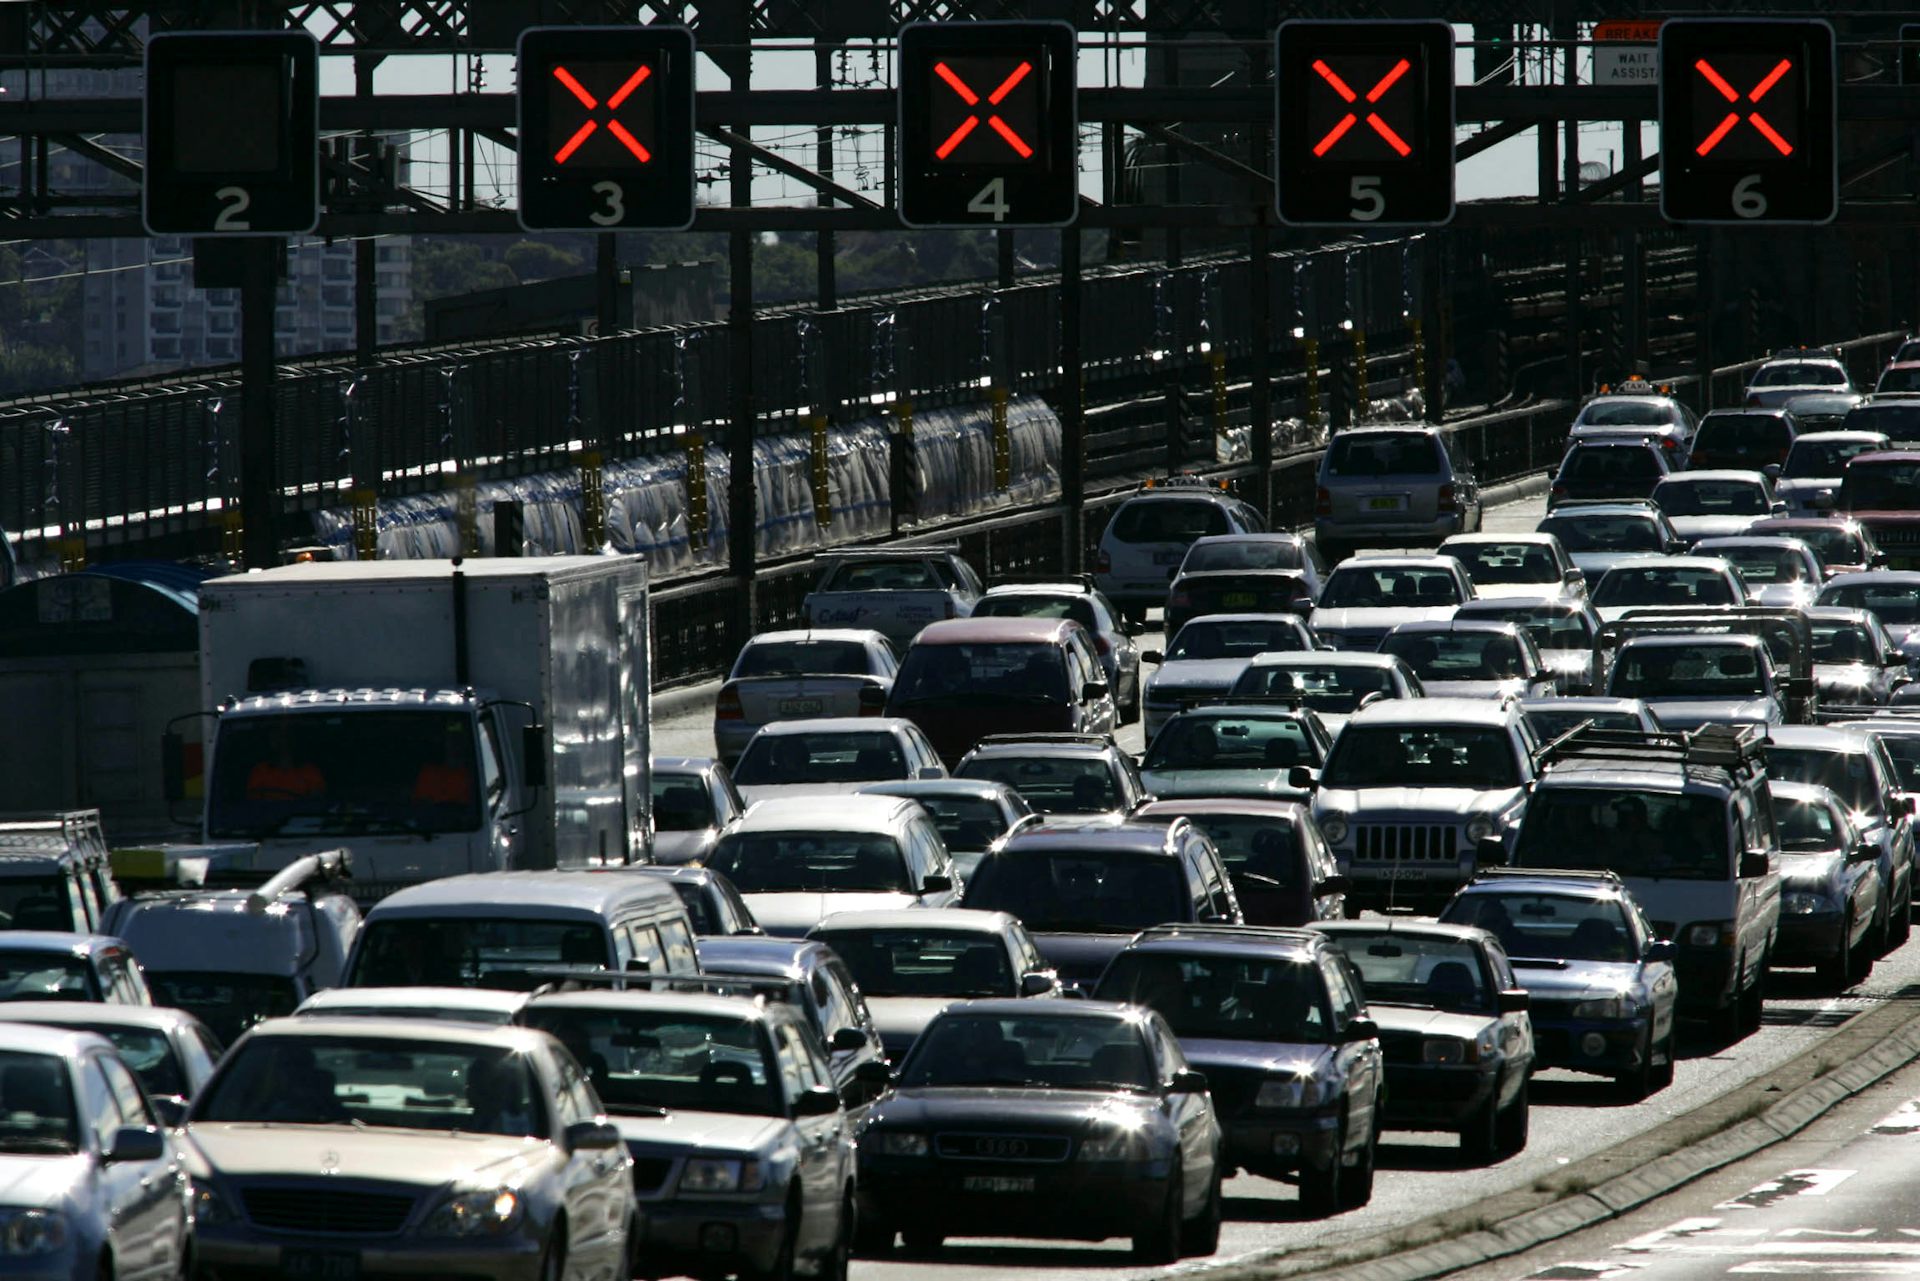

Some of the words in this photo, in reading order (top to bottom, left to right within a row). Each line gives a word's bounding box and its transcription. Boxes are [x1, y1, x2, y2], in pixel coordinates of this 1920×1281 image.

[1611, 68, 1659, 79] ASSIST
[1619, 54, 1648, 63] WAIT
[214, 187, 250, 231] 2
[590, 181, 624, 226] 3
[967, 177, 1010, 222] 4
[1350, 177, 1385, 221] 5
[1731, 175, 1767, 219] 6
[1175, 479, 1201, 487] TAXI
